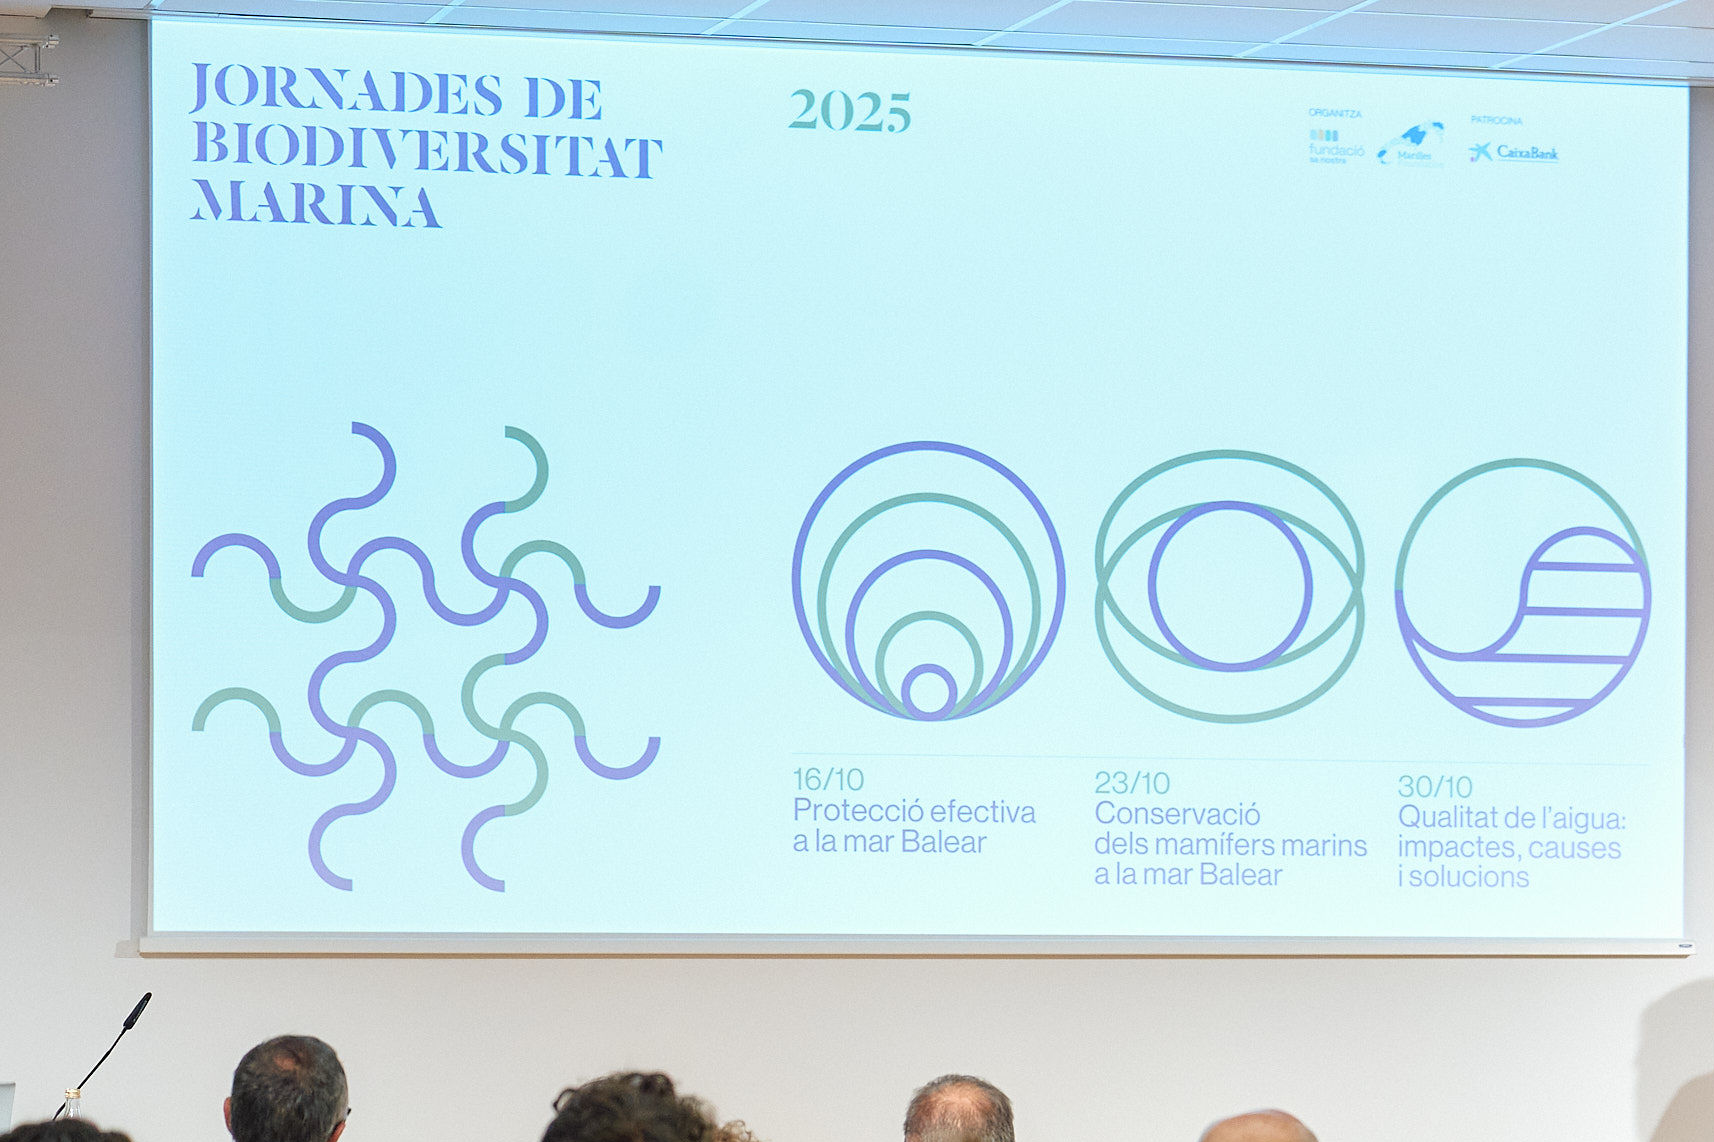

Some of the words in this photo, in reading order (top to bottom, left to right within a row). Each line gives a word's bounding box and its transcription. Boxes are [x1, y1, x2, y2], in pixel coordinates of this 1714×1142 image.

[188, 62, 503, 117] JORNADES
[523, 76, 602, 120] DE
[787, 88, 912, 134] 2025
[1308, 107, 1362, 118] ORGANITZA
[1471, 115, 1523, 125] PATROCINA
[191, 120, 663, 179] BIODIVERSITAT
[1497, 144, 1558, 160] CaixaBank
[189, 178, 443, 229] MARINA
[793, 766, 865, 791] 16/10
[1095, 770, 1171, 795] 23/10
[1398, 774, 1474, 799] 30/10
[793, 797, 924, 822] Protecció
[930, 799, 1037, 824] efectiva
[1095, 800, 1261, 826] Conservació
[1399, 804, 1499, 829] Qualitat
[1504, 806, 1536, 829] de
[1542, 806, 1627, 834] l'aigua:
[793, 833, 809, 852] a
[815, 828, 838, 853] la
[844, 834, 895, 853] mar
[901, 829, 988, 854] Balear
[1094, 831, 1149, 855] dels
[1155, 832, 1276, 856] mamífers
[1282, 833, 1368, 857] marins
[1398, 834, 1522, 862] impactes,
[1528, 840, 1623, 860] causes
[1094, 866, 1110, 885] a
[1116, 861, 1138, 885] la
[1144, 867, 1194, 885] mar
[1200, 861, 1283, 886] Balear
[1408, 864, 1530, 888] solucions
